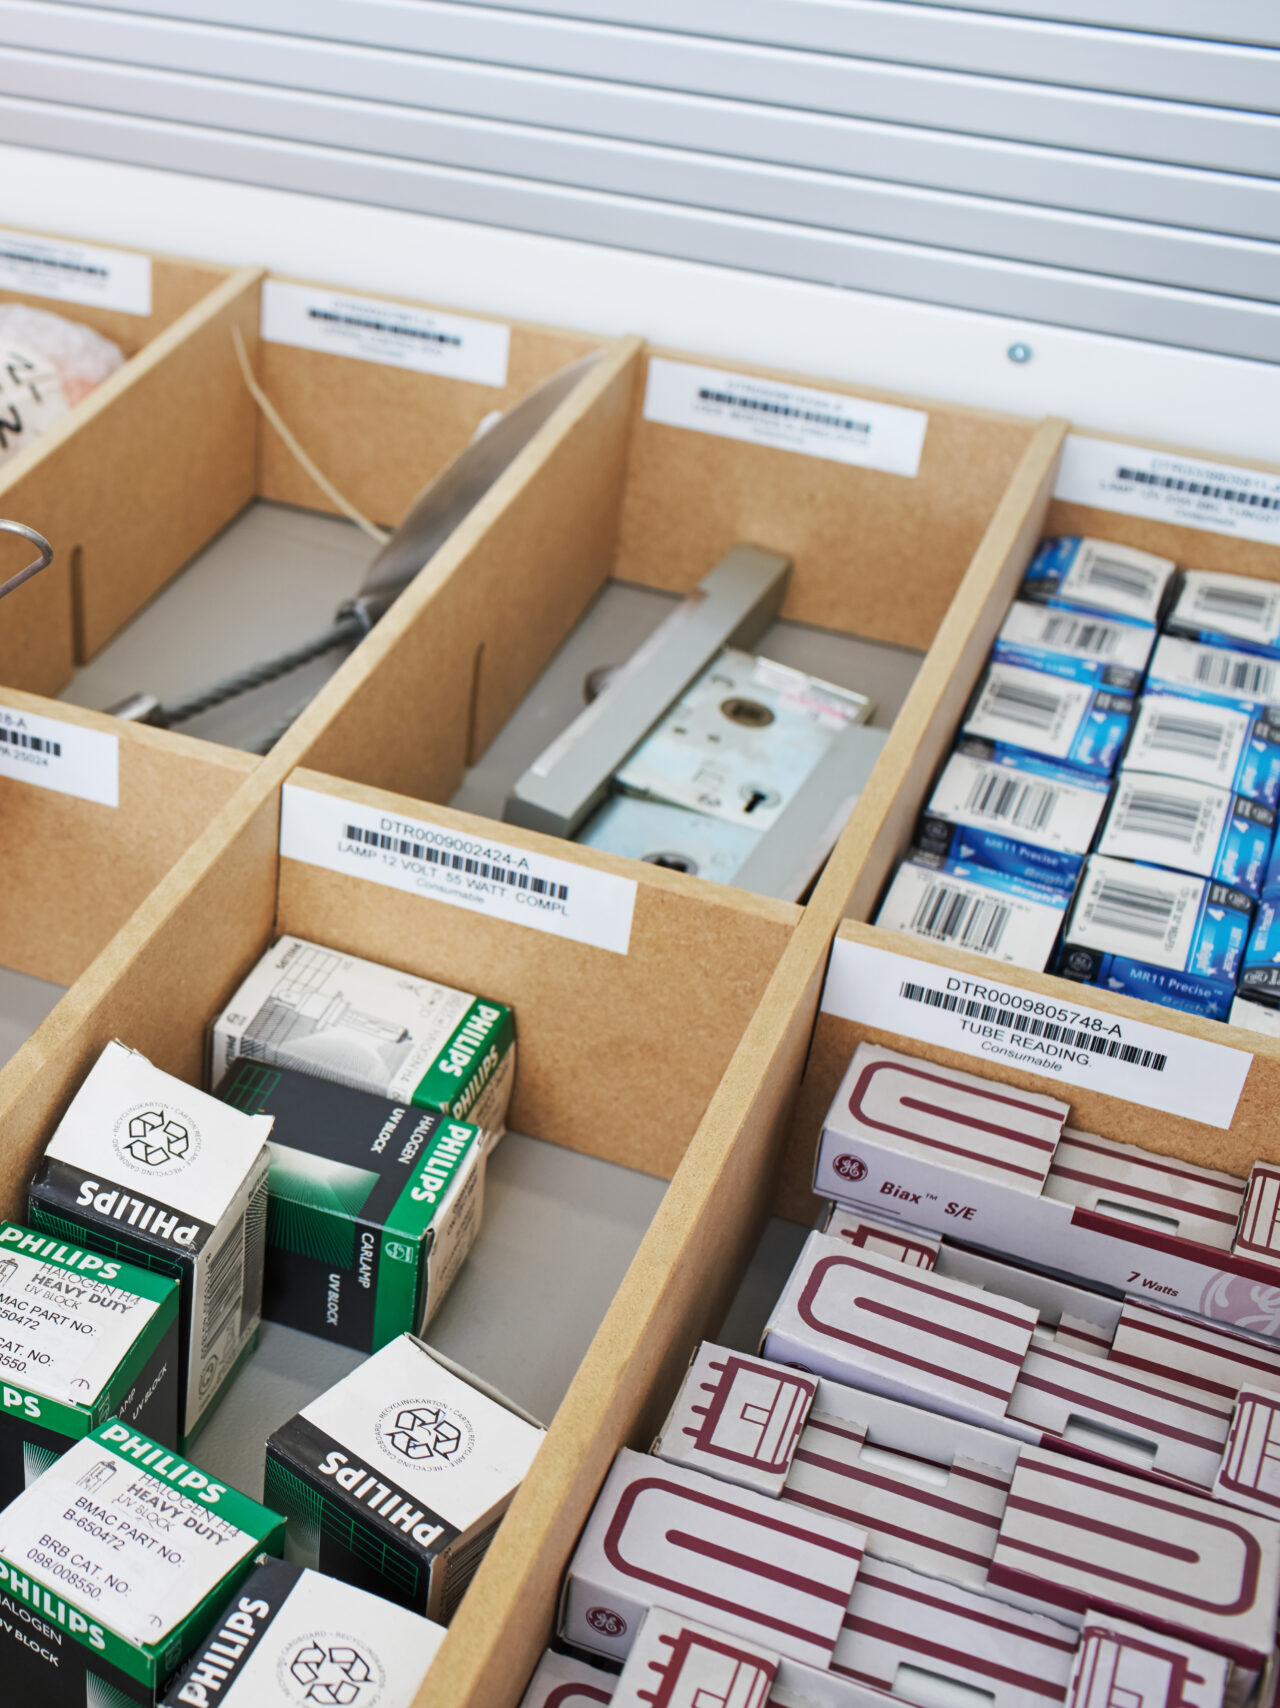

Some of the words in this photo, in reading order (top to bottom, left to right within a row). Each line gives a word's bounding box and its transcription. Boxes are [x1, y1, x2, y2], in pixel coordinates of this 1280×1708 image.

[380, 817, 530, 870] DTR0009002424-A
[337, 841, 377, 861] LAMP
[382, 854, 397, 867] 12
[401, 858, 438, 879] VOLT
[446, 871, 463, 884] 55
[465, 876, 508, 898] WATT
[515, 892, 569, 917] COMPL
[1130, 968, 1165, 986] MR11
[946, 976, 1123, 1039] DTR0009805748-A
[438, 1003, 501, 1078] PHILIPS
[960, 1018, 1005, 1042] TUBE
[1009, 1033, 1092, 1068] READING.
[981, 1040, 1063, 1073] Consumable
[452, 1044, 499, 1120] PHILIPS
[370, 1122, 397, 1154] BLOCK
[391, 1108, 406, 1127] UV
[398, 1115, 435, 1165] HALOGEN
[410, 1123, 472, 1204] PHILIPS
[75, 1179, 201, 1246] PHILIPS
[944, 1201, 977, 1221] S/E
[39, 1261, 116, 1297] HALOGEN
[117, 1288, 143, 1307] H4
[327, 1273, 341, 1293] UV
[357, 1231, 375, 1289] CARLAMP
[1125, 1271, 1142, 1284] 7
[1142, 1277, 1180, 1298] Watts
[24, 1282, 44, 1297] UV
[44, 1288, 83, 1311] BLOCK
[31, 1273, 88, 1303] HEAVY
[91, 1291, 133, 1315] DUTY
[326, 1292, 339, 1327] BLOCK
[30, 1304, 70, 1327] PART
[69, 1318, 97, 1337] NO:
[28, 1349, 55, 1367] NO:
[99, 1423, 227, 1504] PHILIPS
[116, 1493, 136, 1510] UV
[133, 1504, 175, 1534] BLOCK
[126, 1483, 184, 1520] HEAVY
[183, 1516, 231, 1547] DUTY
[138, 1472, 217, 1524] HALOGEN
[218, 1518, 242, 1538] H4
[318, 1451, 446, 1549] PHILIPS
[62, 1508, 126, 1551] B-650472
[74, 1496, 118, 1526] BMAC
[117, 1520, 160, 1550] PART
[157, 1545, 186, 1567] NO:
[26, 1547, 102, 1602] 098/008550.
[38, 1534, 72, 1557] BRB
[70, 1550, 102, 1578] CAT.
[104, 1573, 132, 1597] NO:
[14, 1627, 59, 1667] BLOCK
[177, 1596, 270, 1708] PHILIPS
